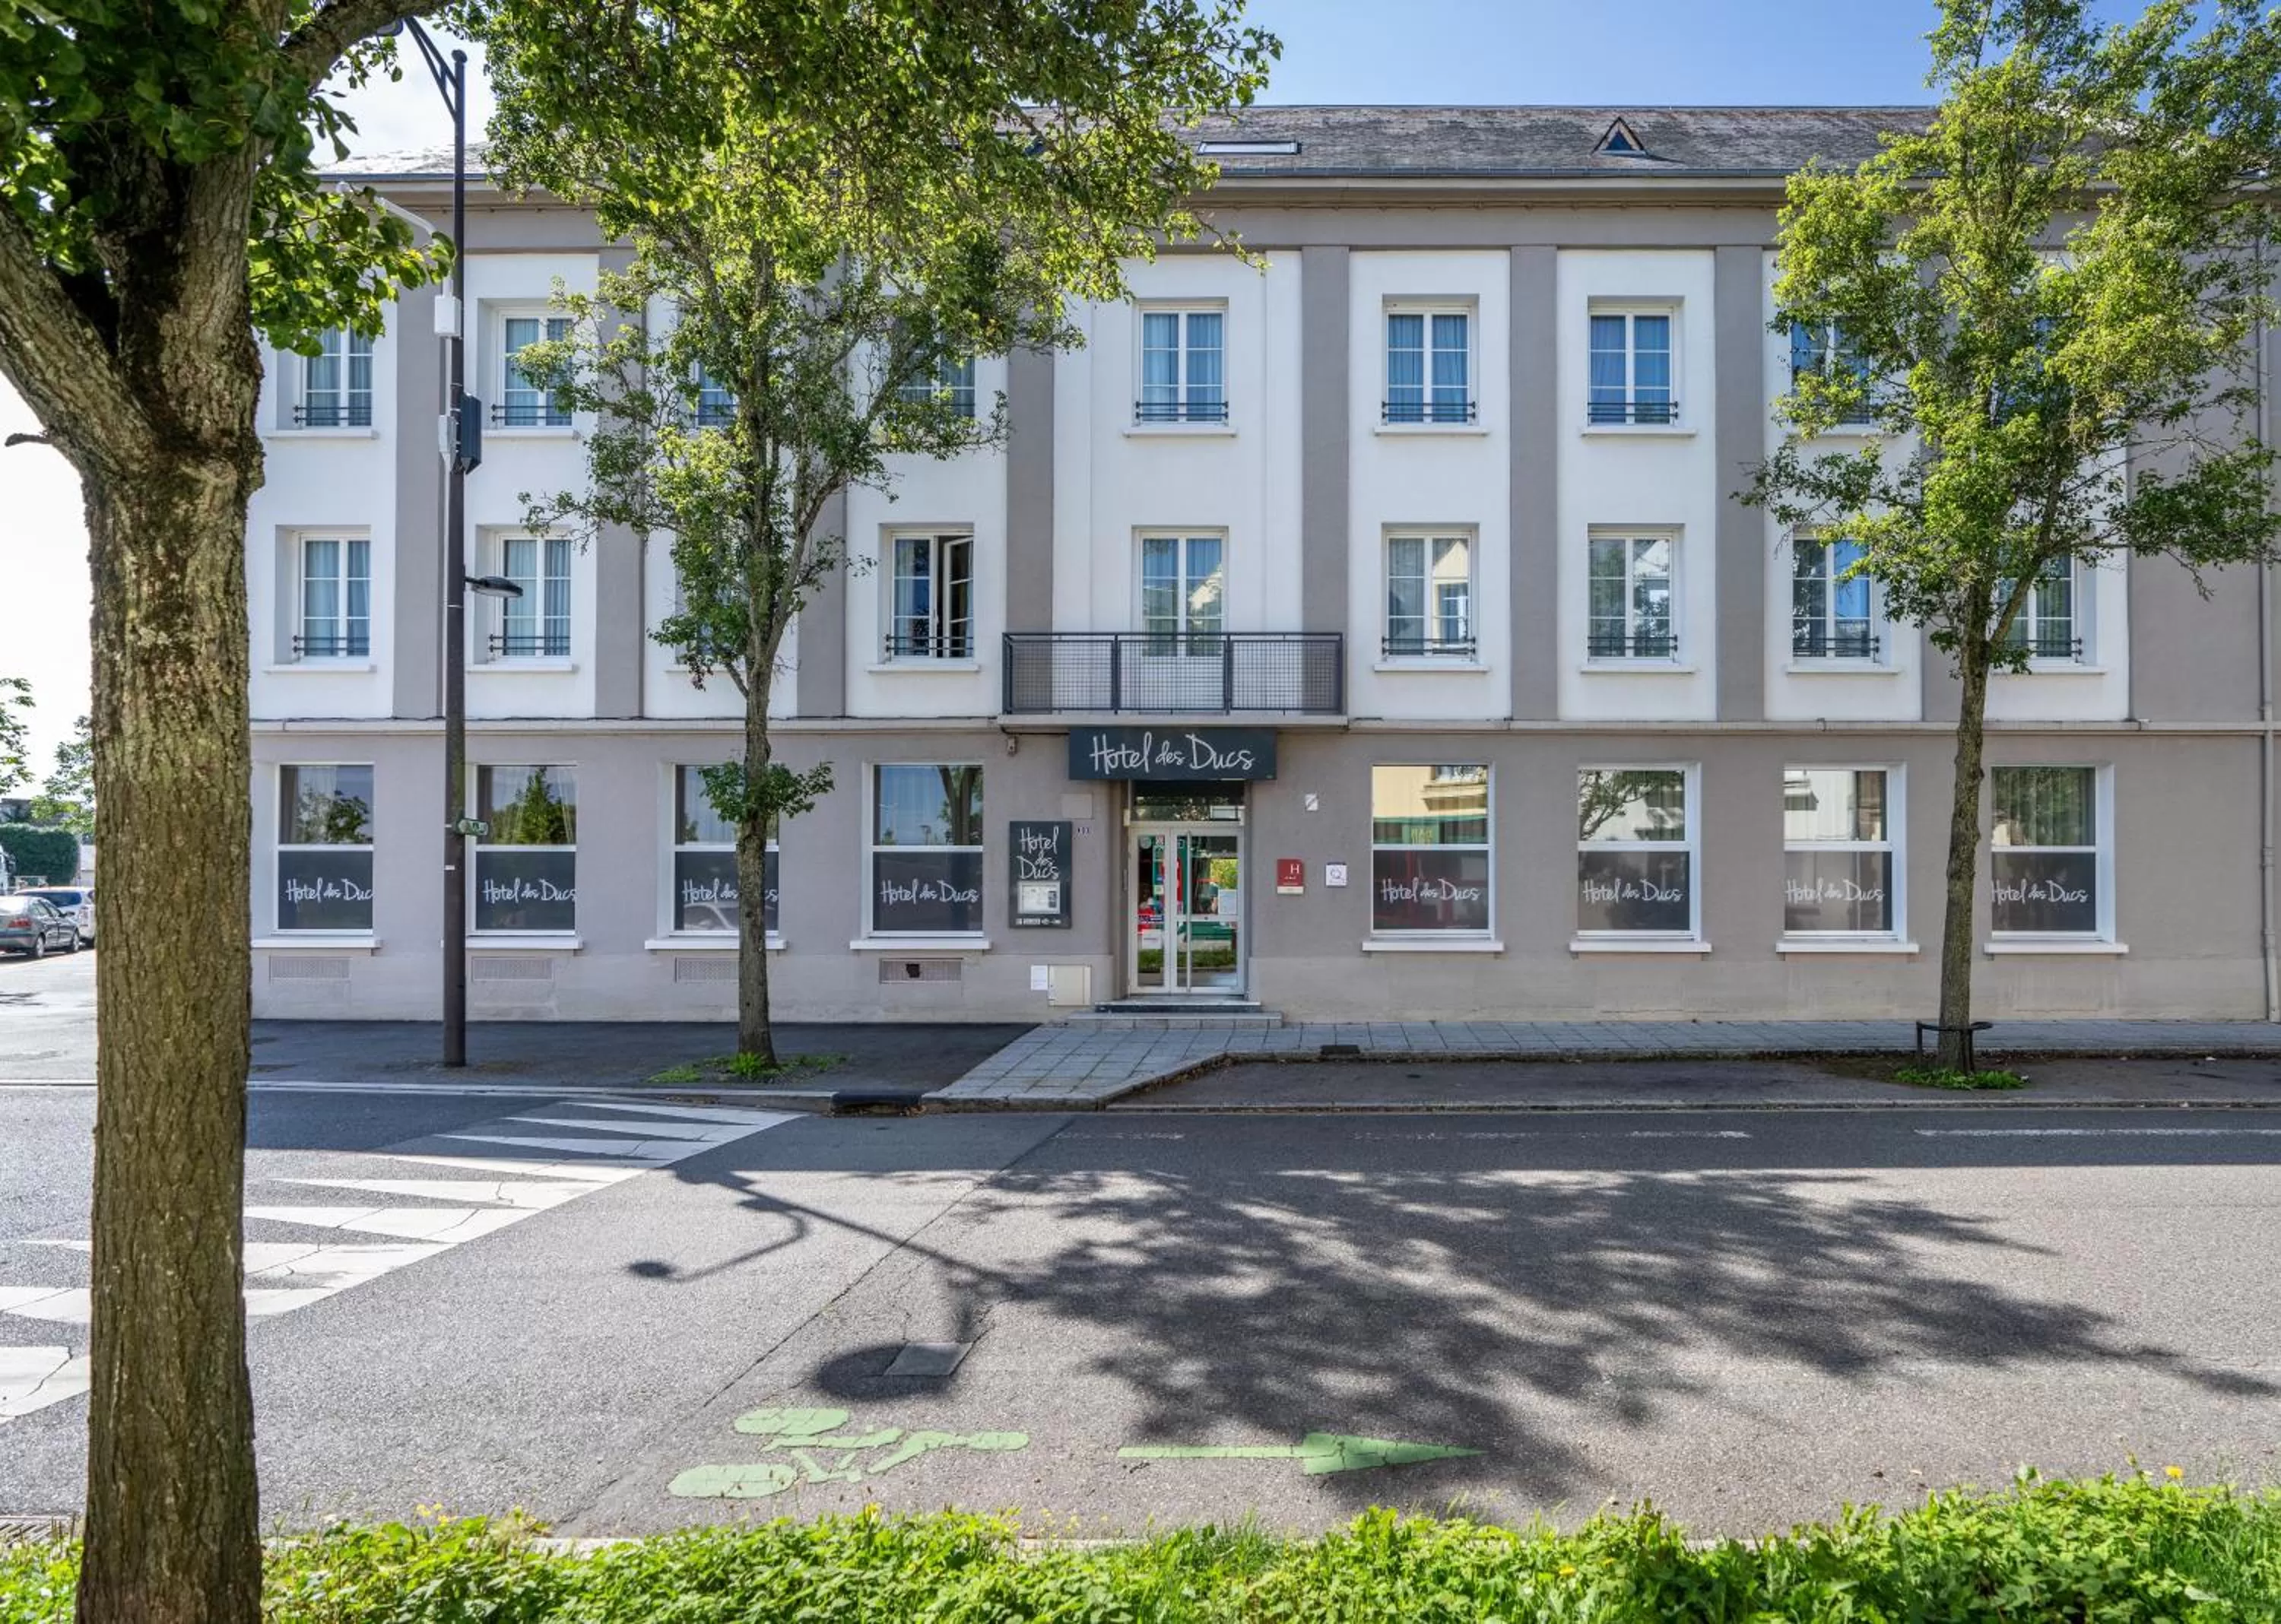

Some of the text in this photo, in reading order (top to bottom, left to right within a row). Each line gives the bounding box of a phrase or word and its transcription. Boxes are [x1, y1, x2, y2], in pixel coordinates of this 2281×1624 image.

[1090, 731, 1255, 775] Hotel des Ducs
[1019, 826, 1059, 854] Hotel
[1016, 855, 1059, 880] Ducs
[1035, 849, 1053, 866] des
[1290, 863, 1300, 874] H
[285, 877, 323, 903] Hotel
[481, 877, 521, 904] Hotel
[681, 877, 719, 904] Hotel
[880, 878, 918, 905] Hotel
[936, 880, 979, 903] Ducs
[1380, 877, 1420, 903] Hotel
[1437, 877, 1481, 901] Ducs
[1582, 877, 1621, 903] Hotel
[1639, 878, 1683, 902] Ducs
[1785, 877, 1824, 903] Hotel
[1842, 879, 1885, 902] Ducs
[1991, 878, 2027, 906] Hotel
[2045, 879, 2089, 903] Ducs
